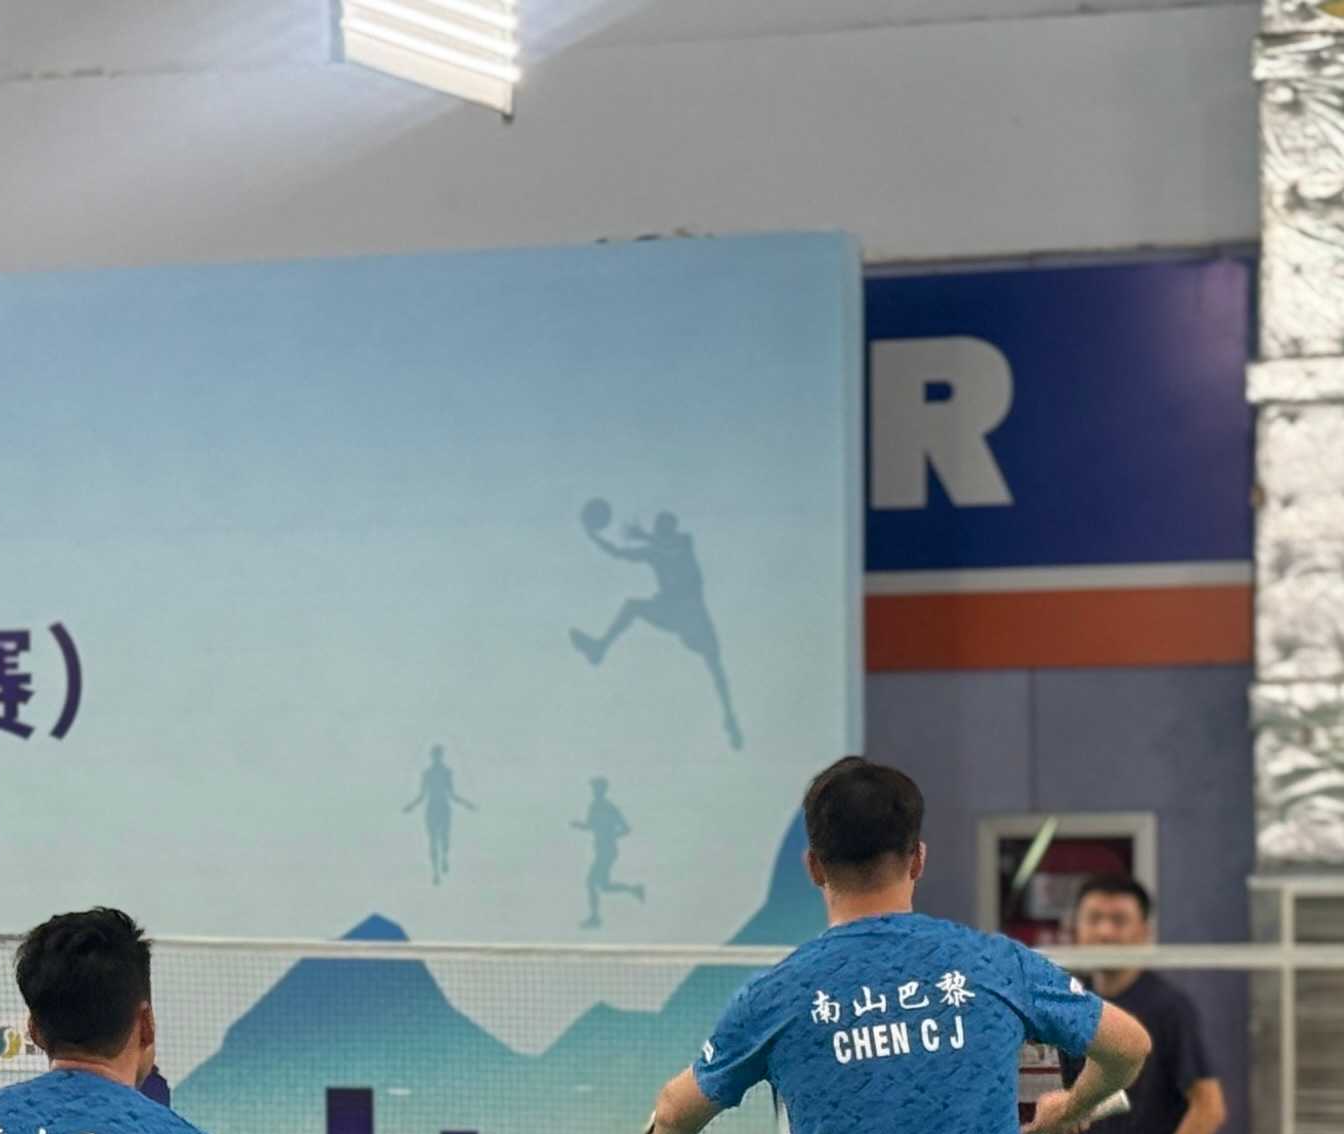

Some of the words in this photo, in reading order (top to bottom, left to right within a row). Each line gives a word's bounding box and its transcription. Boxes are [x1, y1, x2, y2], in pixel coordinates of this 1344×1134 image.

[810, 971, 976, 1025] 南山巴黎
[832, 1024, 910, 1065] CHEN
[921, 1018, 940, 1053] C
[949, 1015, 966, 1050] J
